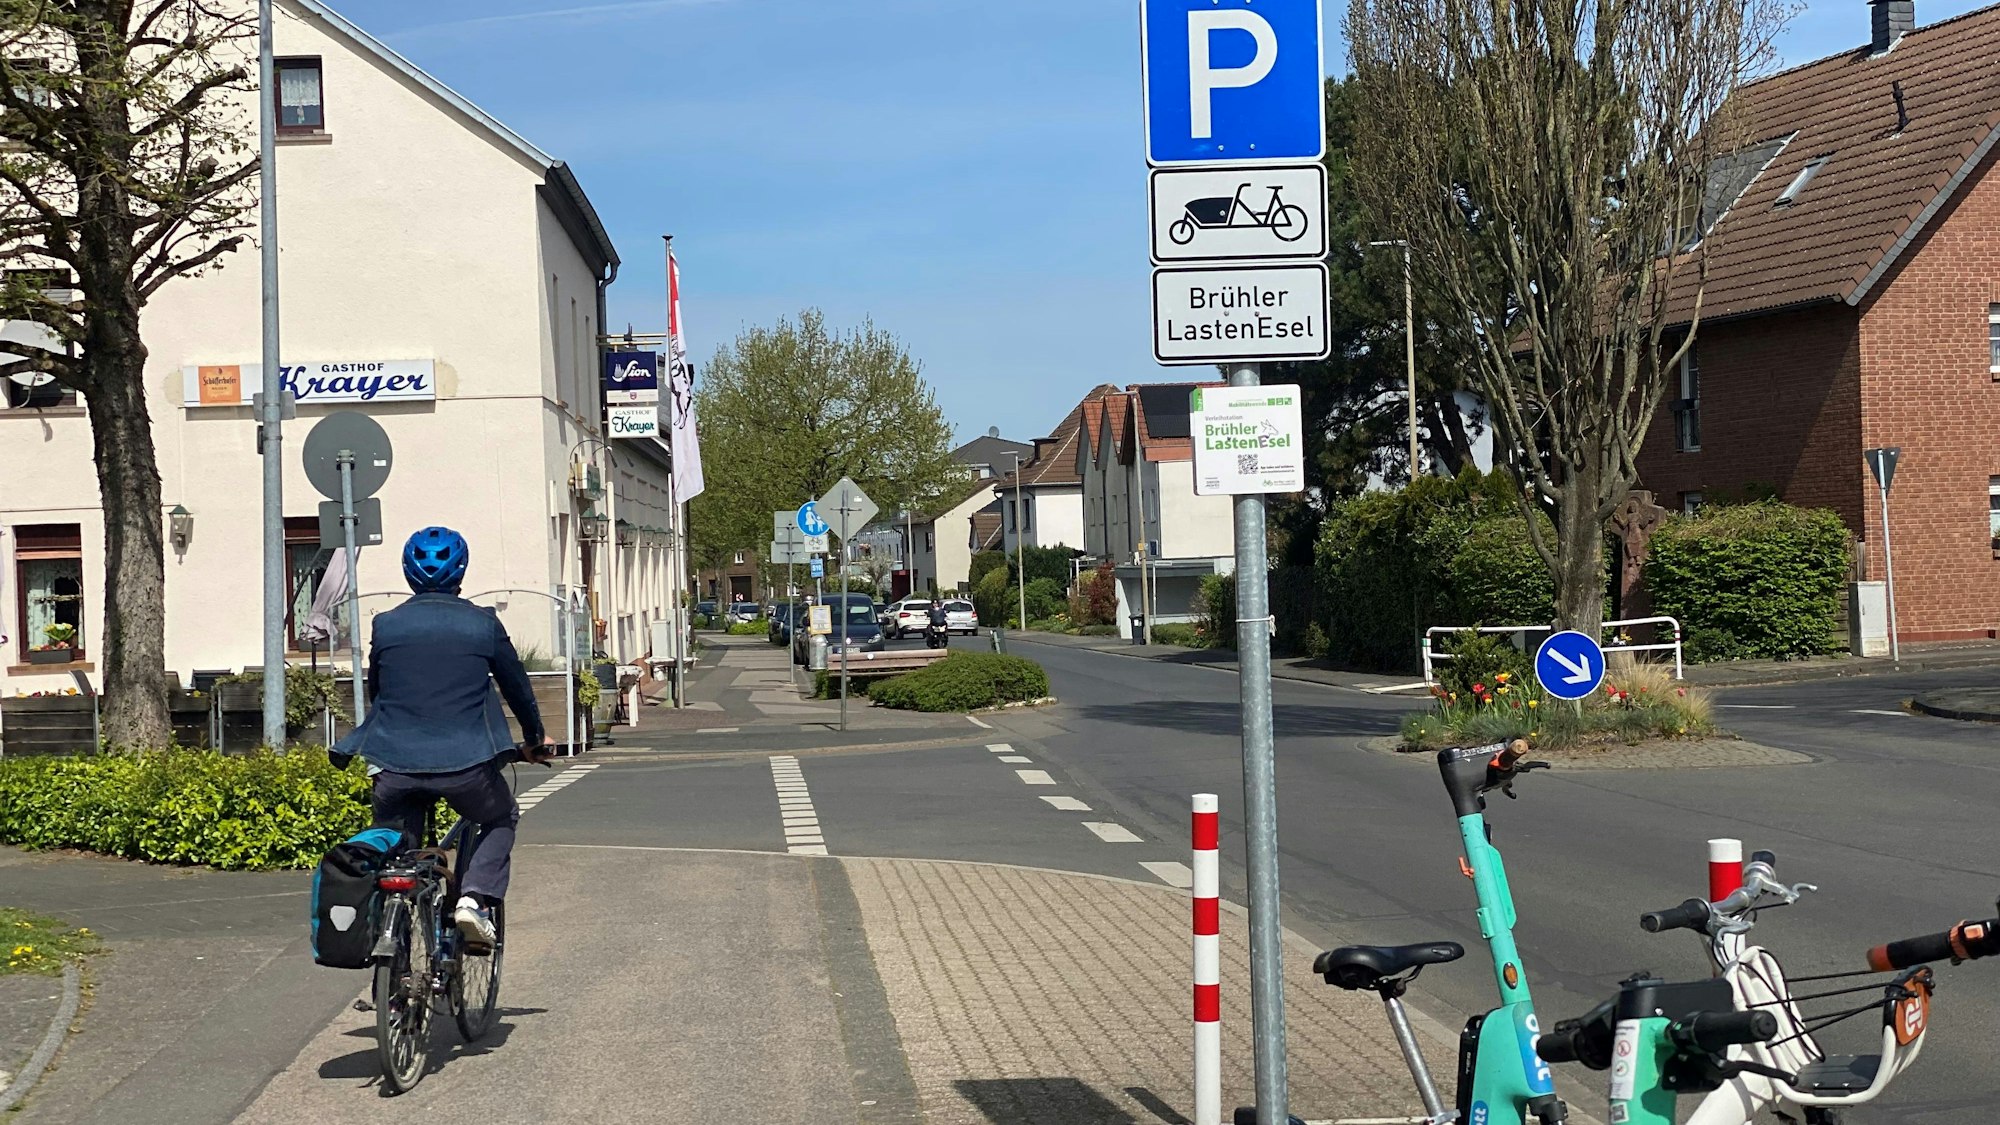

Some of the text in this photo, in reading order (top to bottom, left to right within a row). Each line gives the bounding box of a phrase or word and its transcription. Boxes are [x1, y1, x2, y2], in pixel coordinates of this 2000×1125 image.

[1187, 9, 1278, 139] P
[1190, 286, 1289, 309] Brühler
[1168, 315, 1314, 341] LastenEsel
[321, 362, 385, 373] GASTHOF
[612, 360, 651, 382] Sion
[279, 366, 428, 401] Krayer
[612, 416, 654, 433] Krayer
[1205, 423, 1258, 436] Brühler
[1206, 434, 1290, 450] LastenEsel
